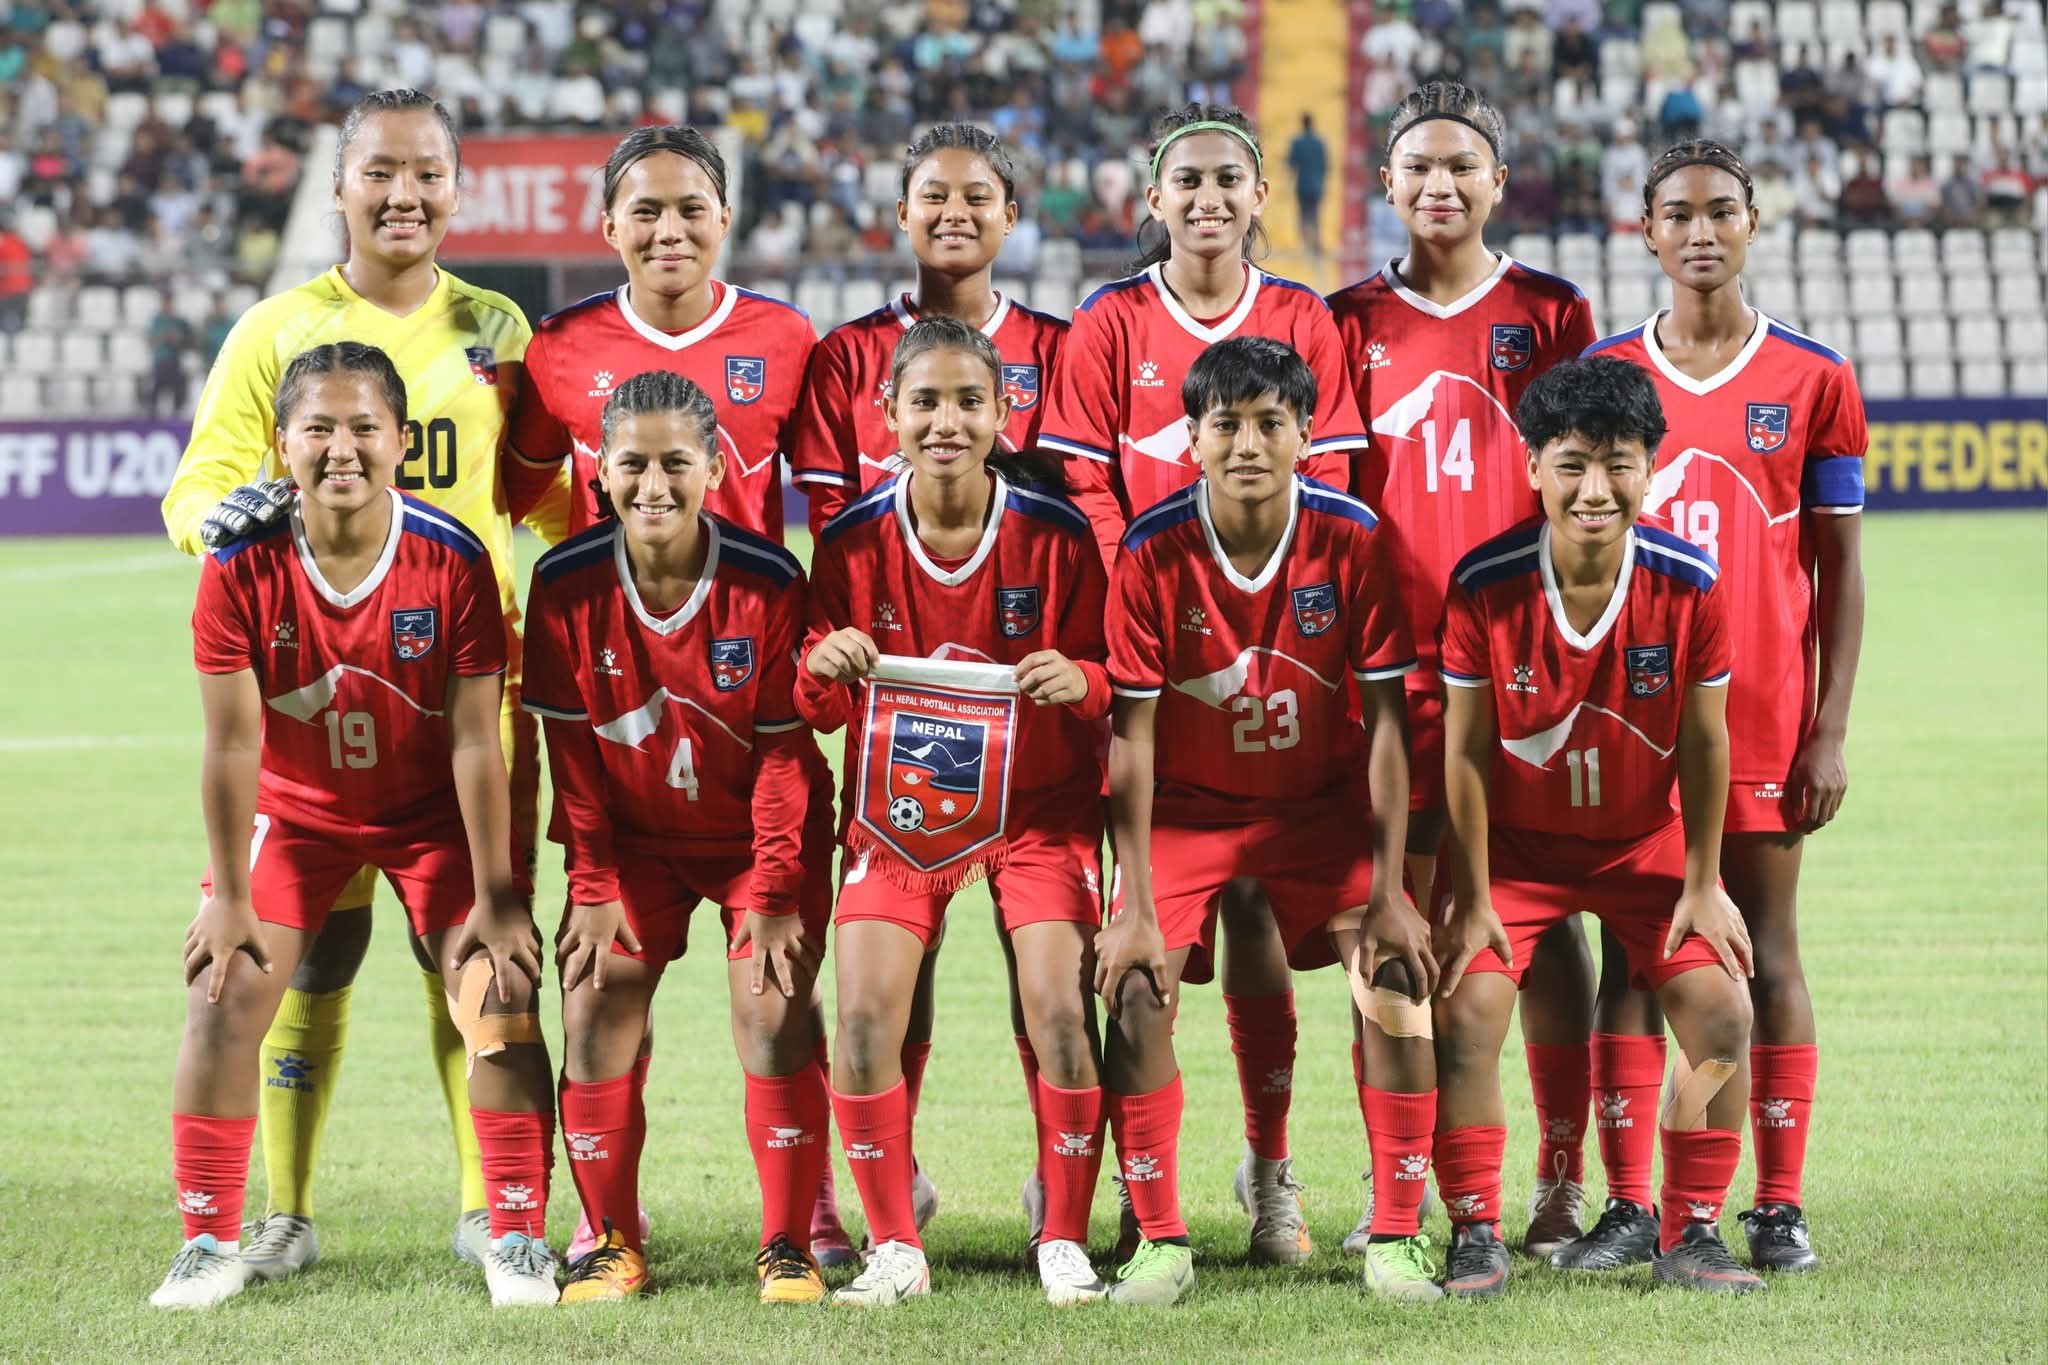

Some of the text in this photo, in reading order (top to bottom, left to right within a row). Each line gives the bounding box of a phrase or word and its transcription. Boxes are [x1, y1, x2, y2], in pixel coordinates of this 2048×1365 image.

[1362, 359, 1392, 370] KELME
[1132, 379, 1164, 387] KELME
[395, 418, 457, 490] 20
[1421, 418, 1475, 492] 14
[65, 430, 180, 499] U20
[1670, 500, 1720, 568] 18
[403, 614, 424, 622] NEPAL
[871, 621, 902, 631] KELME
[1180, 623, 1213, 636] KELME
[270, 640, 300, 649] KELME
[593, 666, 623, 676] KELME
[1505, 682, 1539, 694] KELME
[881, 692, 1005, 717] ALL NEPAL FOOTBALL ASSOCIATION
[1231, 688, 1300, 753] 23
[911, 720, 966, 741] NEPAL
[325, 710, 379, 769] 19
[665, 737, 700, 801] 4
[1566, 747, 1602, 807] 11
[267, 1077, 315, 1093] KELME
[767, 1134, 815, 1148] KELME
[1053, 1143, 1095, 1156] KELME
[1125, 1170, 1164, 1181] KELME
[495, 1200, 538, 1211] KELME
[1447, 1202, 1486, 1217] KELME
